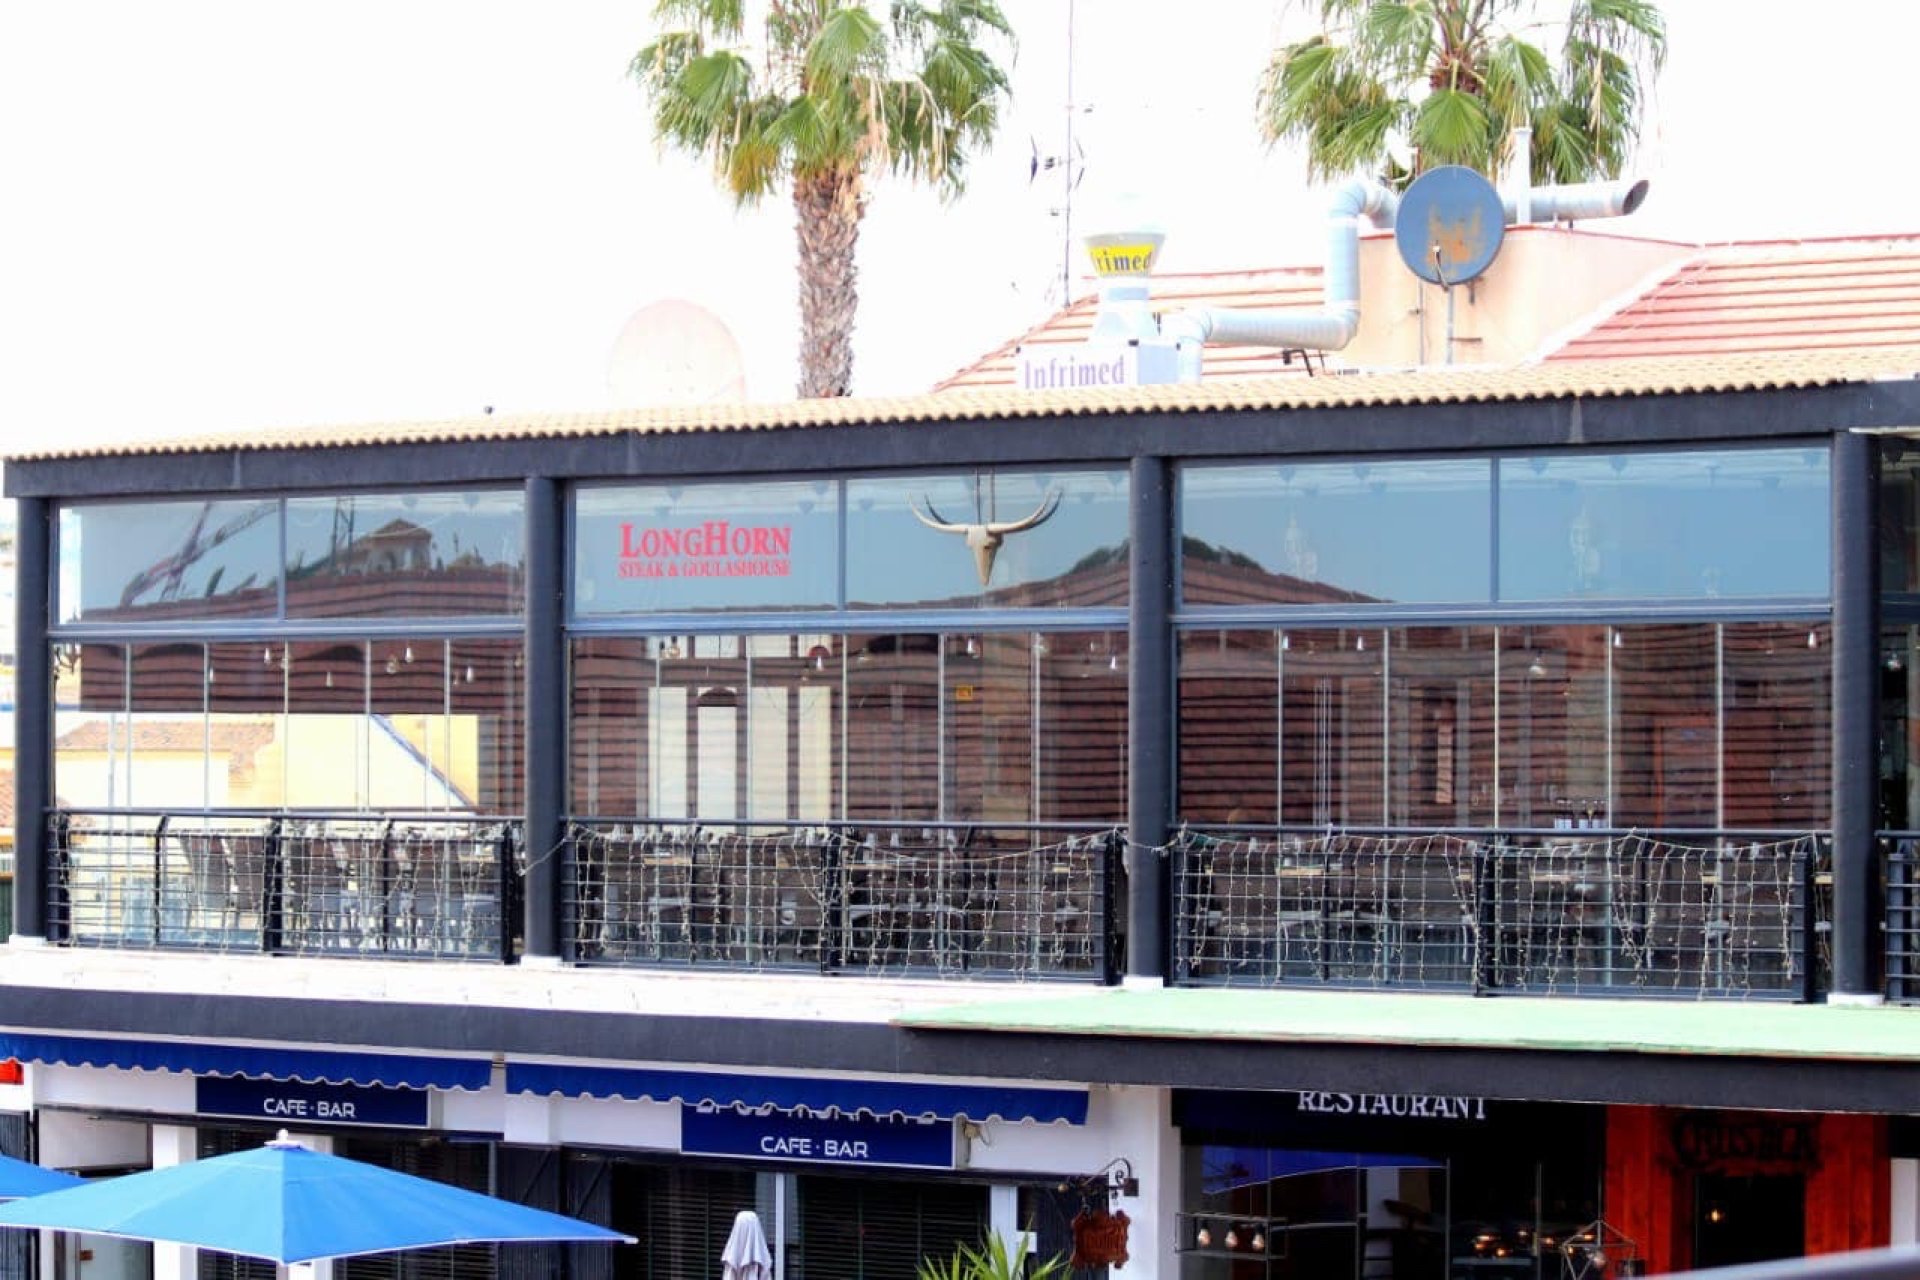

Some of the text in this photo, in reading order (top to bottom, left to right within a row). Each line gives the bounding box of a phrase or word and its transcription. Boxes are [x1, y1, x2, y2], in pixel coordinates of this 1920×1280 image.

[1025, 354, 1125, 389] Infrimed
[618, 560, 664, 578] STEAK
[667, 560, 679, 577] &
[263, 1098, 355, 1118] CAFE BAR
[1297, 1090, 1486, 1119] RESTAURANT
[760, 1135, 869, 1158] CAFE BAR
